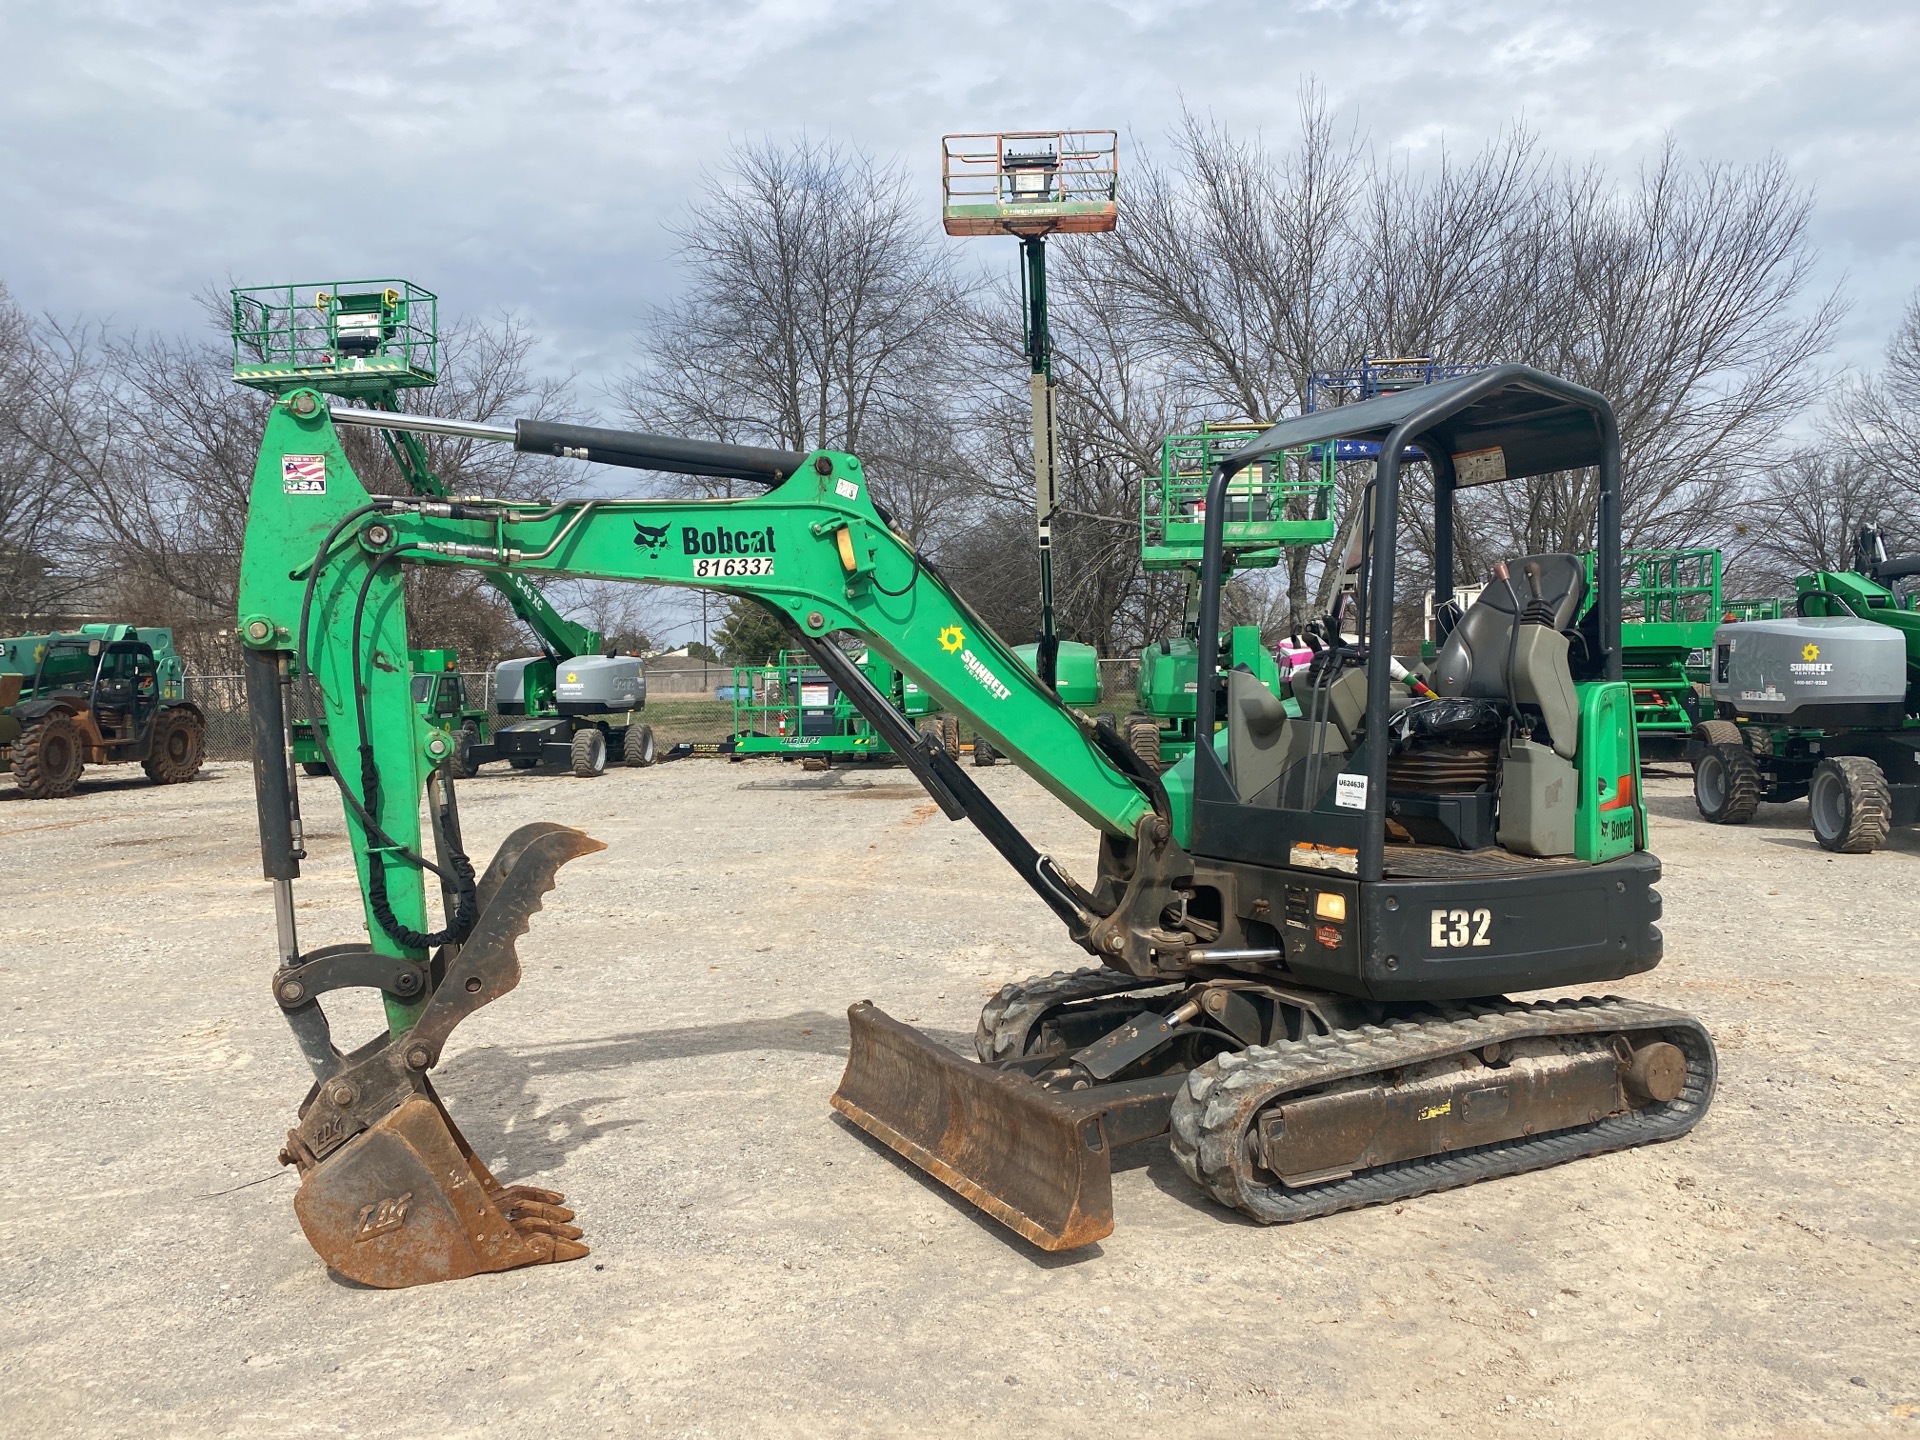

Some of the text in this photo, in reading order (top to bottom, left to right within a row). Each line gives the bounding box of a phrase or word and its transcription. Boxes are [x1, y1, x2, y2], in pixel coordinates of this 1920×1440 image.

[287, 481, 323, 491] USA
[682, 526, 776, 555] Bobcat
[696, 558, 773, 577] 816337
[516, 576, 543, 611] S-45 XC
[961, 649, 1012, 701] SUNBELT
[963, 664, 998, 700] RENTALS
[1790, 663, 1834, 672] SUNBELT
[1611, 816, 1633, 841] Bobcat
[1430, 908, 1491, 947] E32
